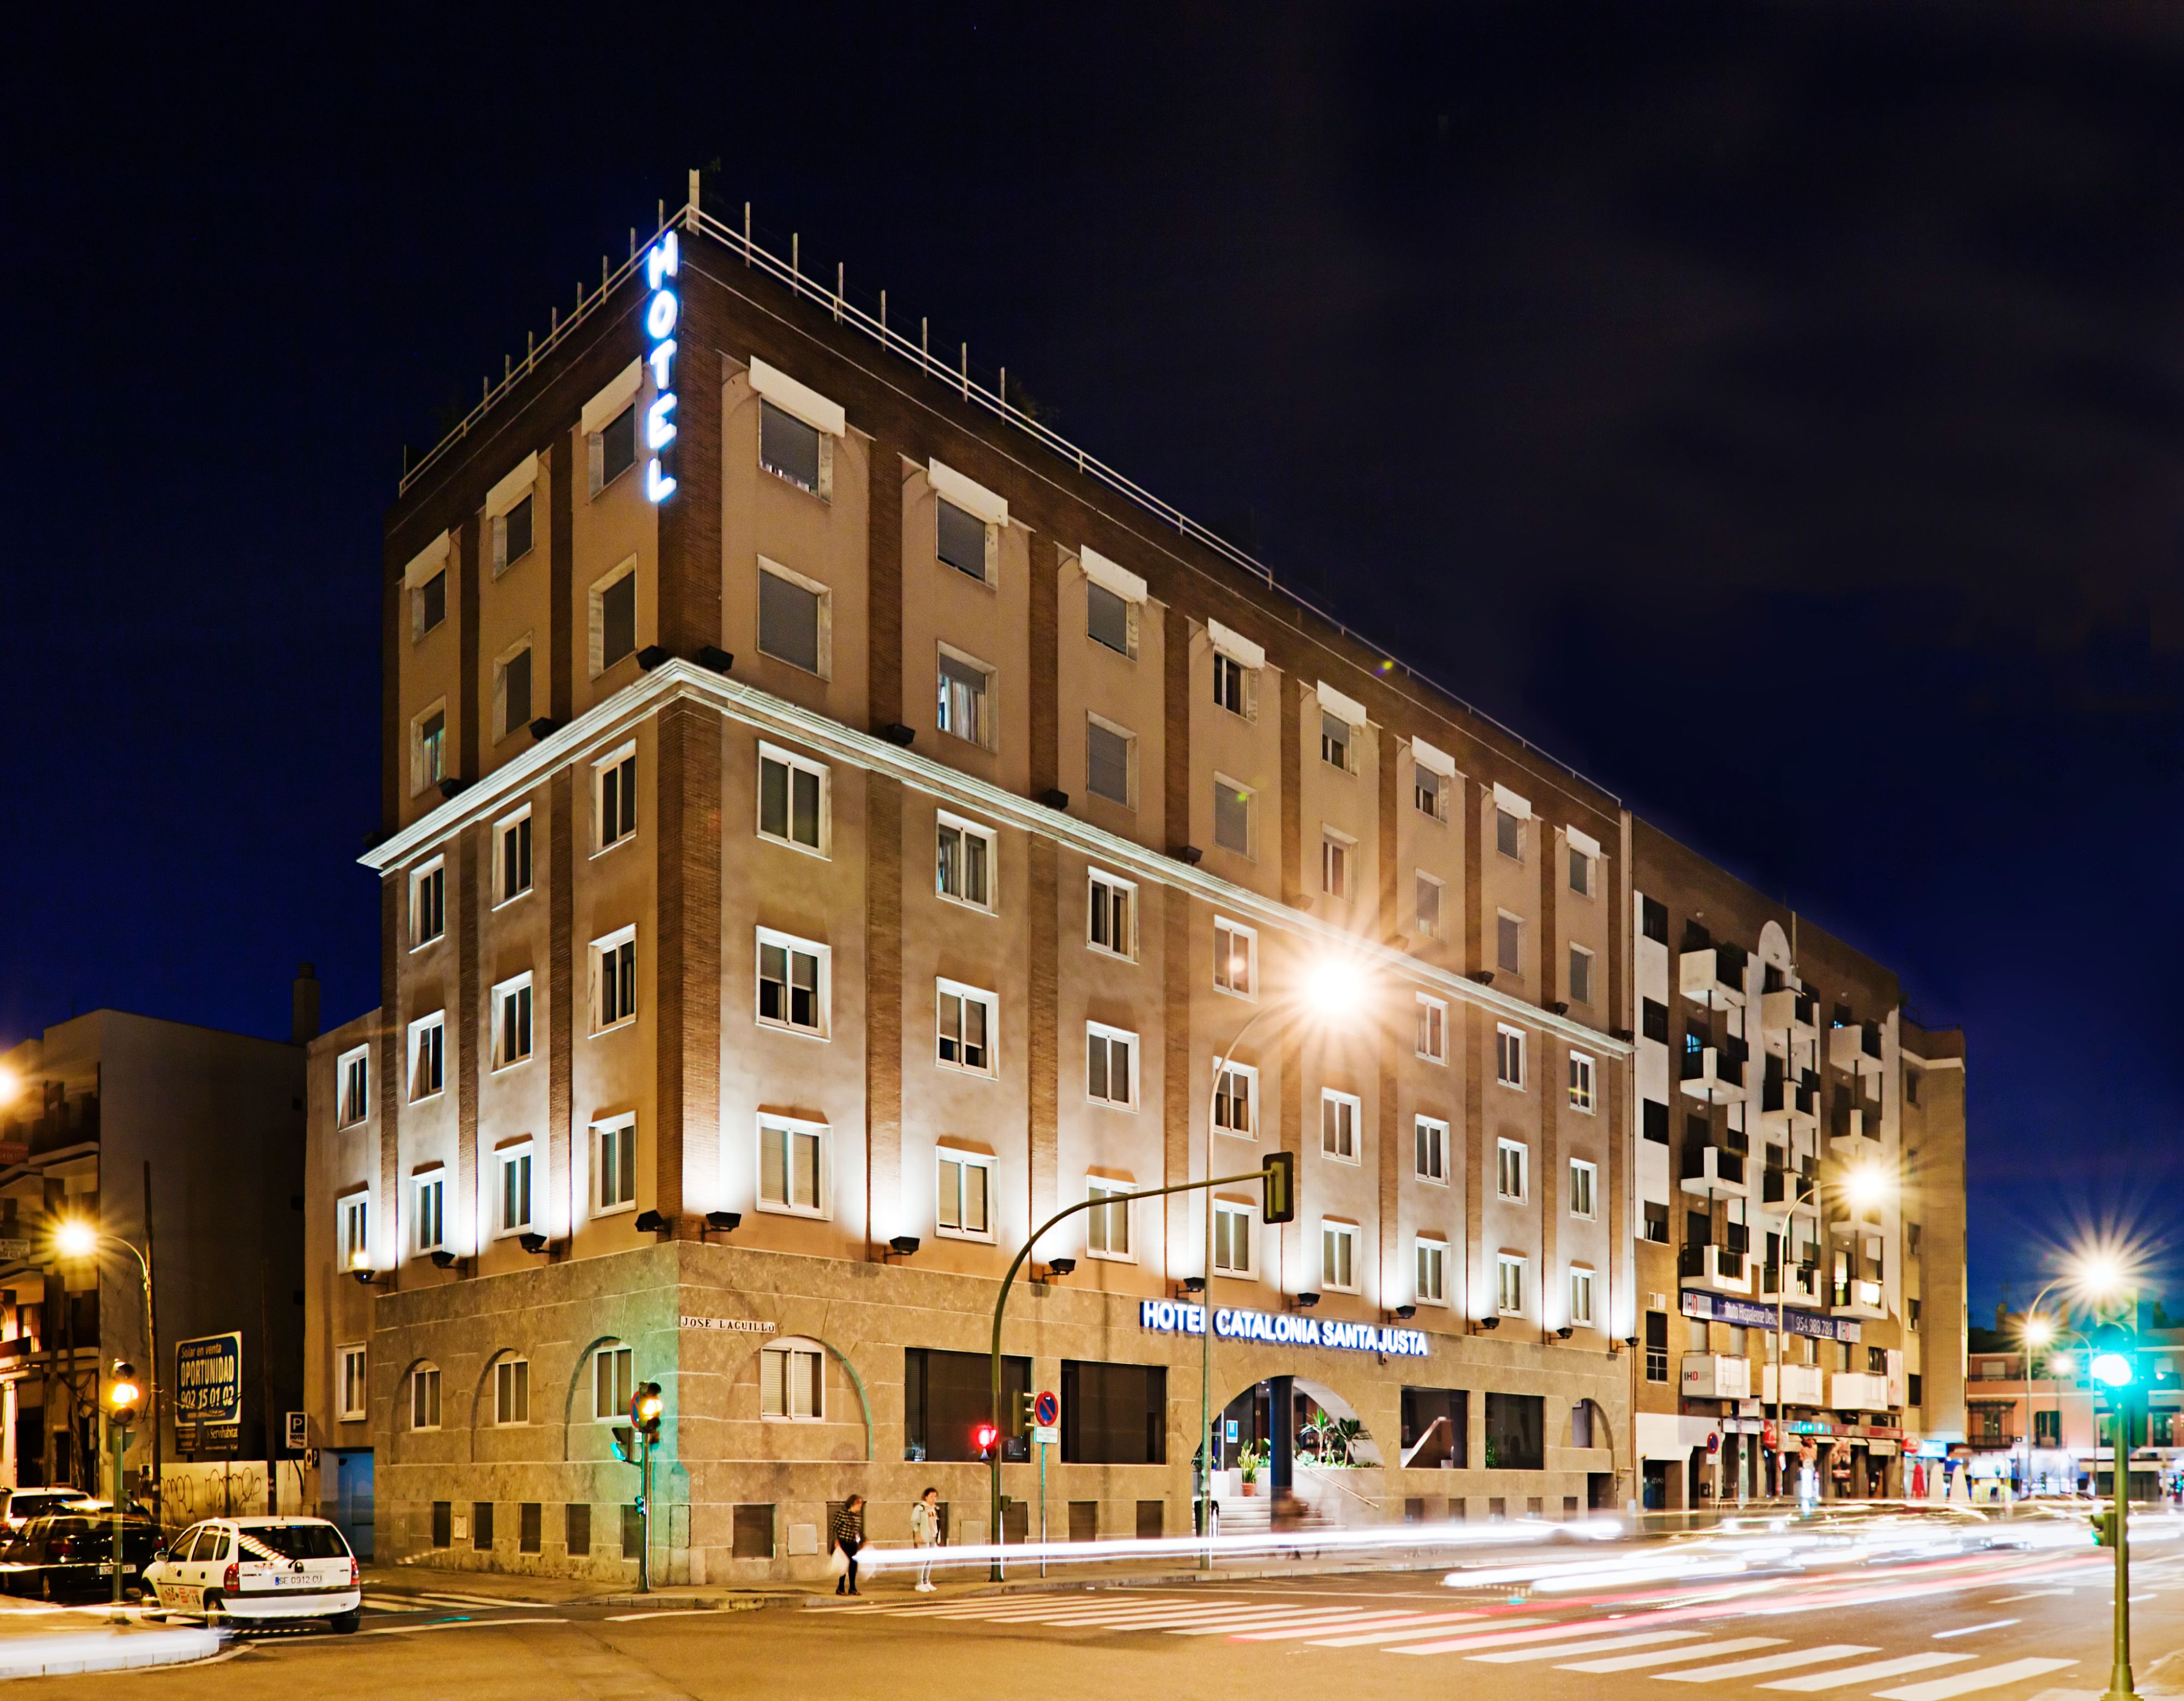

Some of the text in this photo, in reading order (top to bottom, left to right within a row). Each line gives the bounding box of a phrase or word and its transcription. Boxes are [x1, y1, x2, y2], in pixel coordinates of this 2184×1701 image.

[648, 230, 678, 502] HOTEL
[682, 1317, 711, 1328] JOSE
[1796, 1316, 1833, 1336] 954 989 789
[1215, 1308, 1320, 1345] CATALONIA
[1321, 1320, 1378, 1351] SANTA
[1378, 1328, 1428, 1356] JUSTA
[181, 1343, 222, 1359] Solar en venta
[181, 1355, 234, 1387] OPORTUNIDAD
[1684, 1371, 1698, 1381] IHD
[181, 1385, 234, 1409] 902 15 01 02
[293, 1418, 302, 1430] P
[291, 1576, 310, 1584] 0912
[312, 1575, 322, 1583] CU
